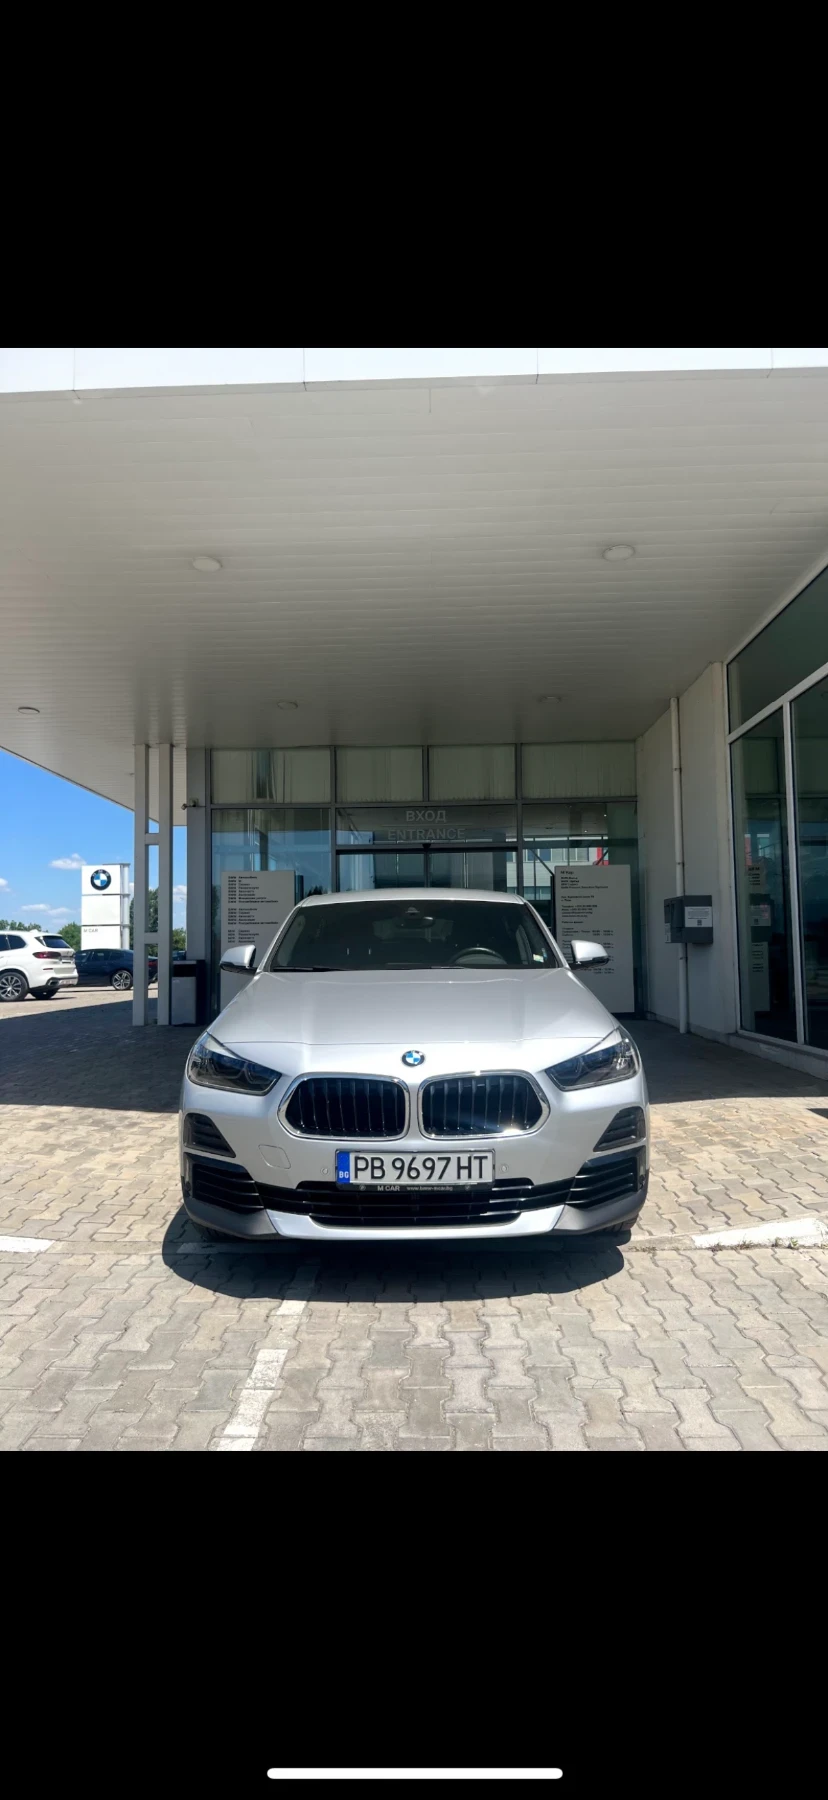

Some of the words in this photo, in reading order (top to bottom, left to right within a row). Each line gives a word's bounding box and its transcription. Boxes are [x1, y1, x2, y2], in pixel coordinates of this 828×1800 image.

[406, 810, 446, 823] ВХОД
[387, 828, 466, 840] ENTRANCE
[354, 1156, 386, 1180] PB
[391, 1156, 451, 1180] 9697
[457, 1155, 488, 1179] HT
[339, 1171, 349, 1179] BG
